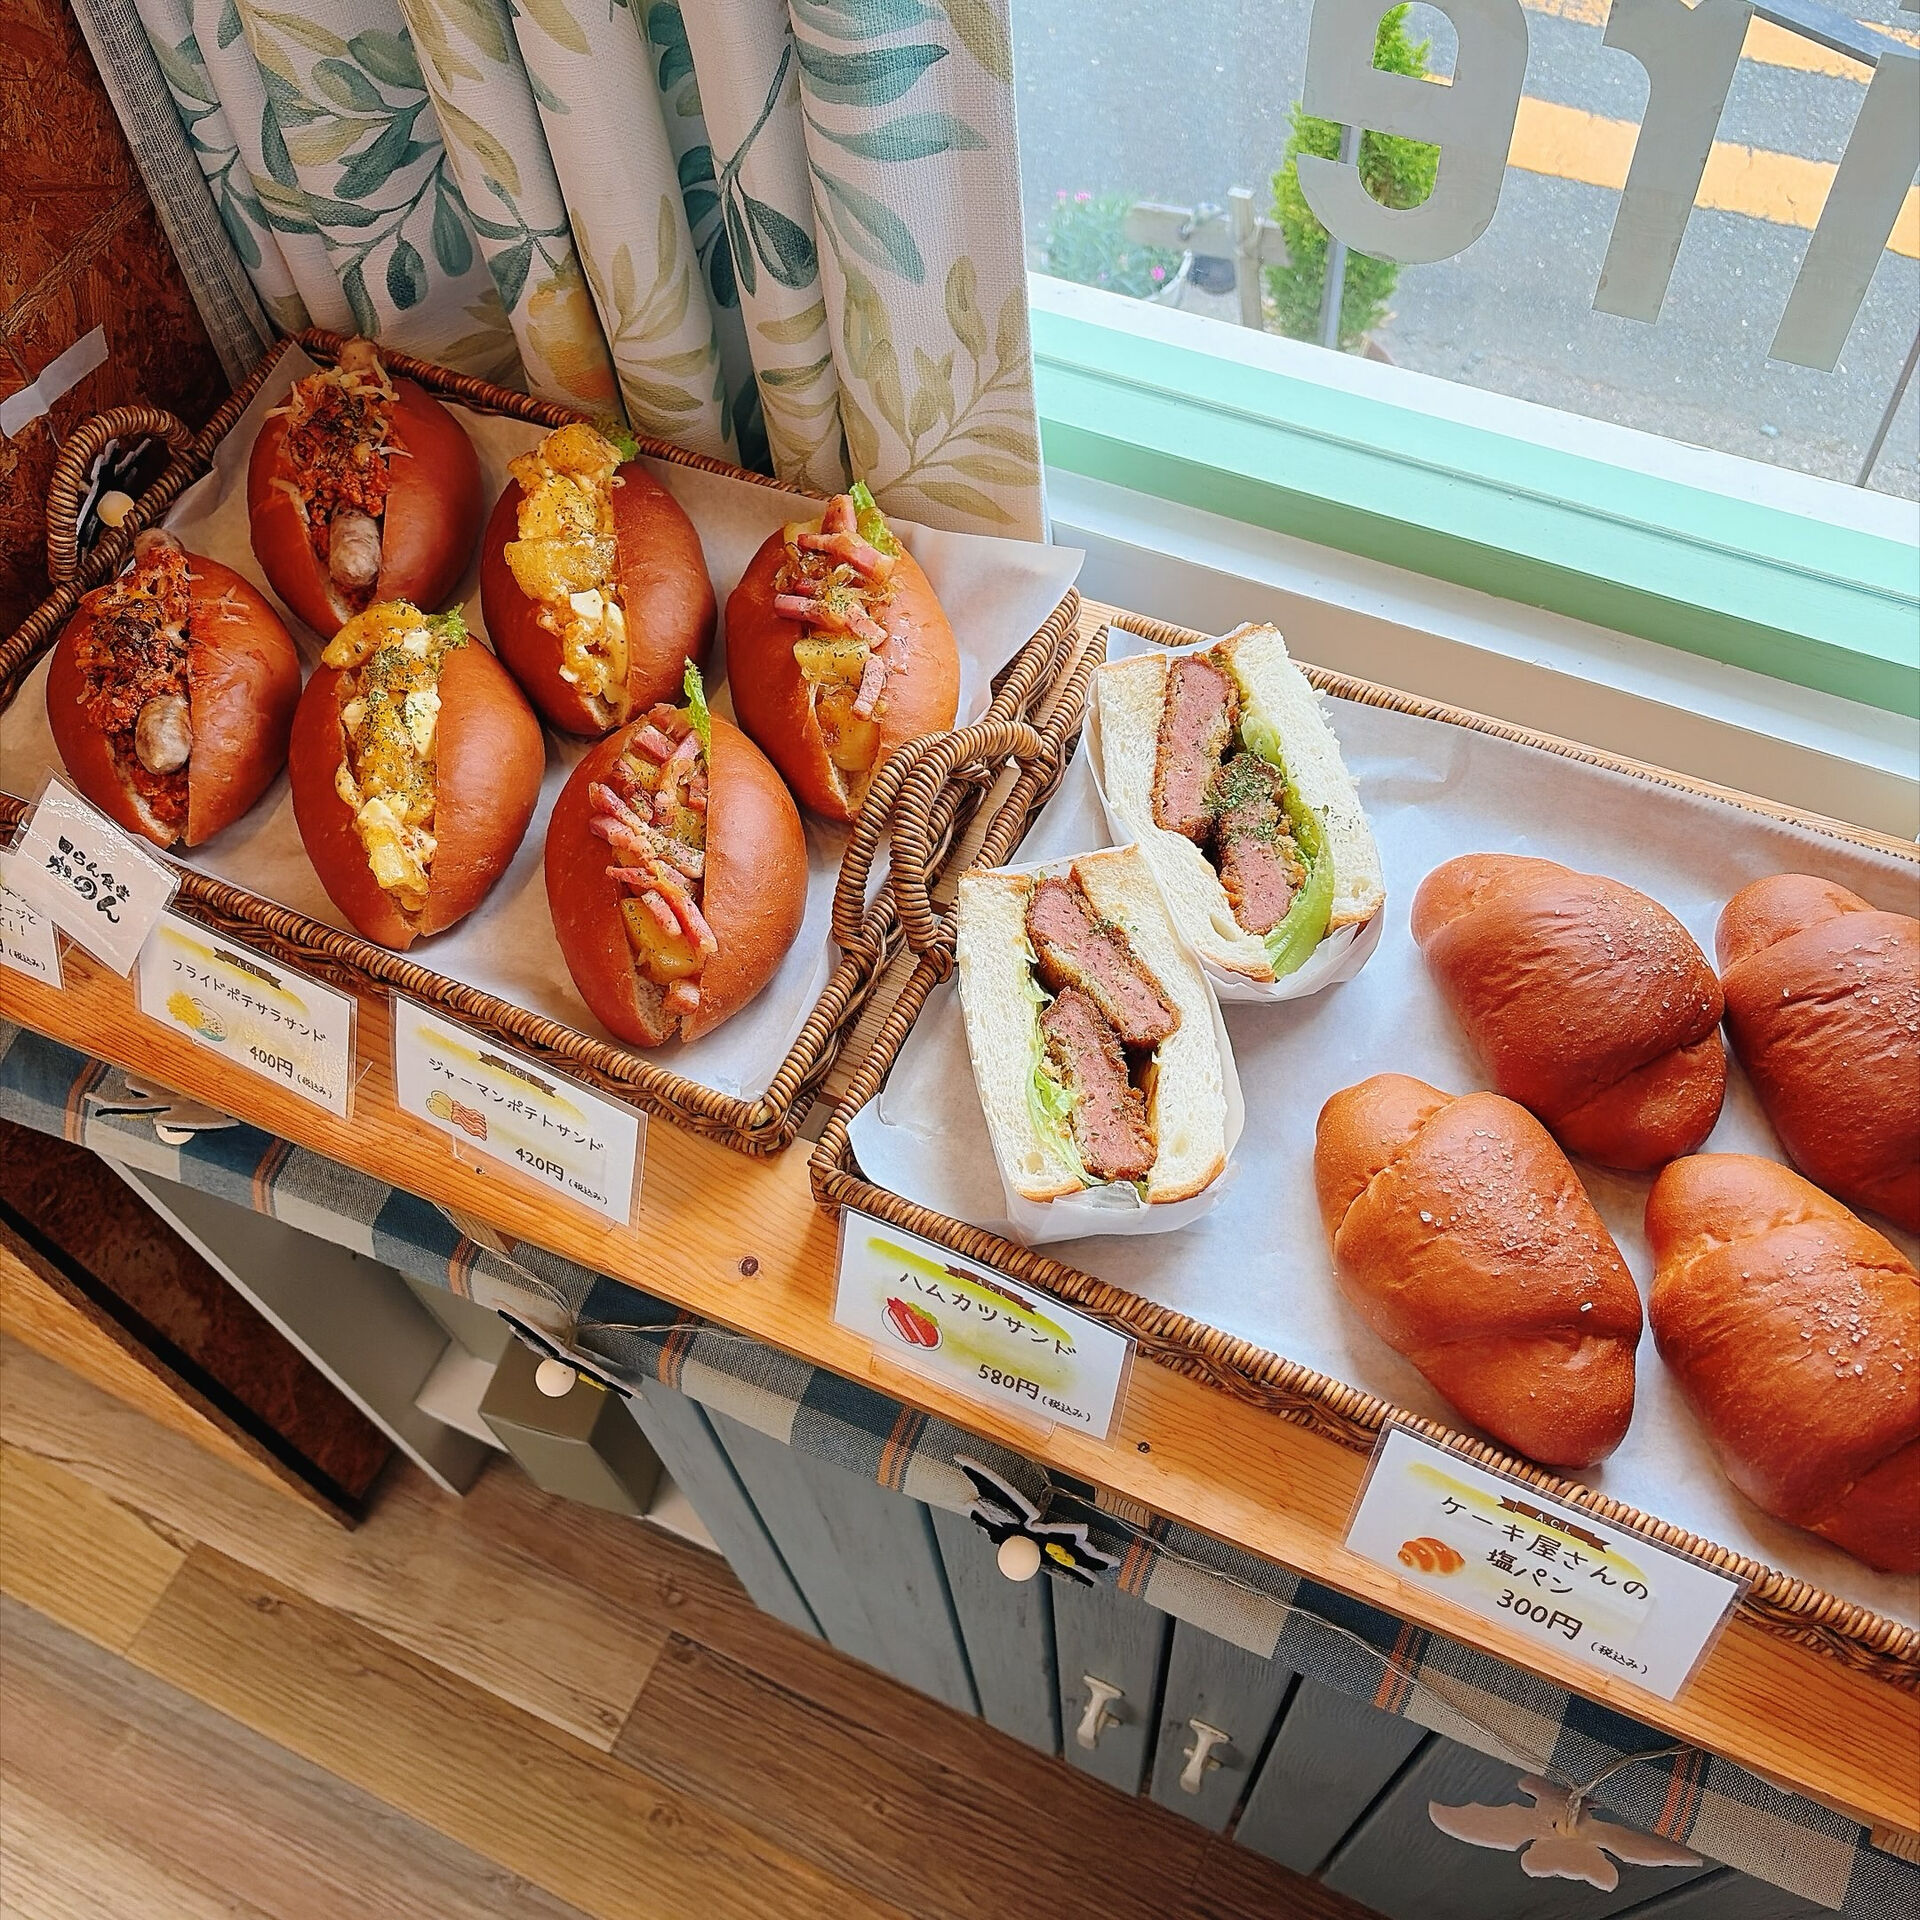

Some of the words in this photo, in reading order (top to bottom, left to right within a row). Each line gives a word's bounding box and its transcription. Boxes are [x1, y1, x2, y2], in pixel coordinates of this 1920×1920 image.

[0, 903, 36, 926] ージと
[172, 959, 327, 1042] フライドポテサラサンド
[249, 1046, 293, 1078] 400円
[428, 1057, 604, 1152] ジャーマンポテトサンド
[515, 1148, 564, 1181] 420円
[899, 1272, 1077, 1356] ハムカツサンド
[978, 1363, 1039, 1400] 580円
[1441, 1496, 1649, 1600] ケーキ屋さんの
[1485, 1549, 1573, 1595] 塩パン
[1496, 1589, 1583, 1640] 300円
[1590, 1642, 1648, 1675] (税込み)
